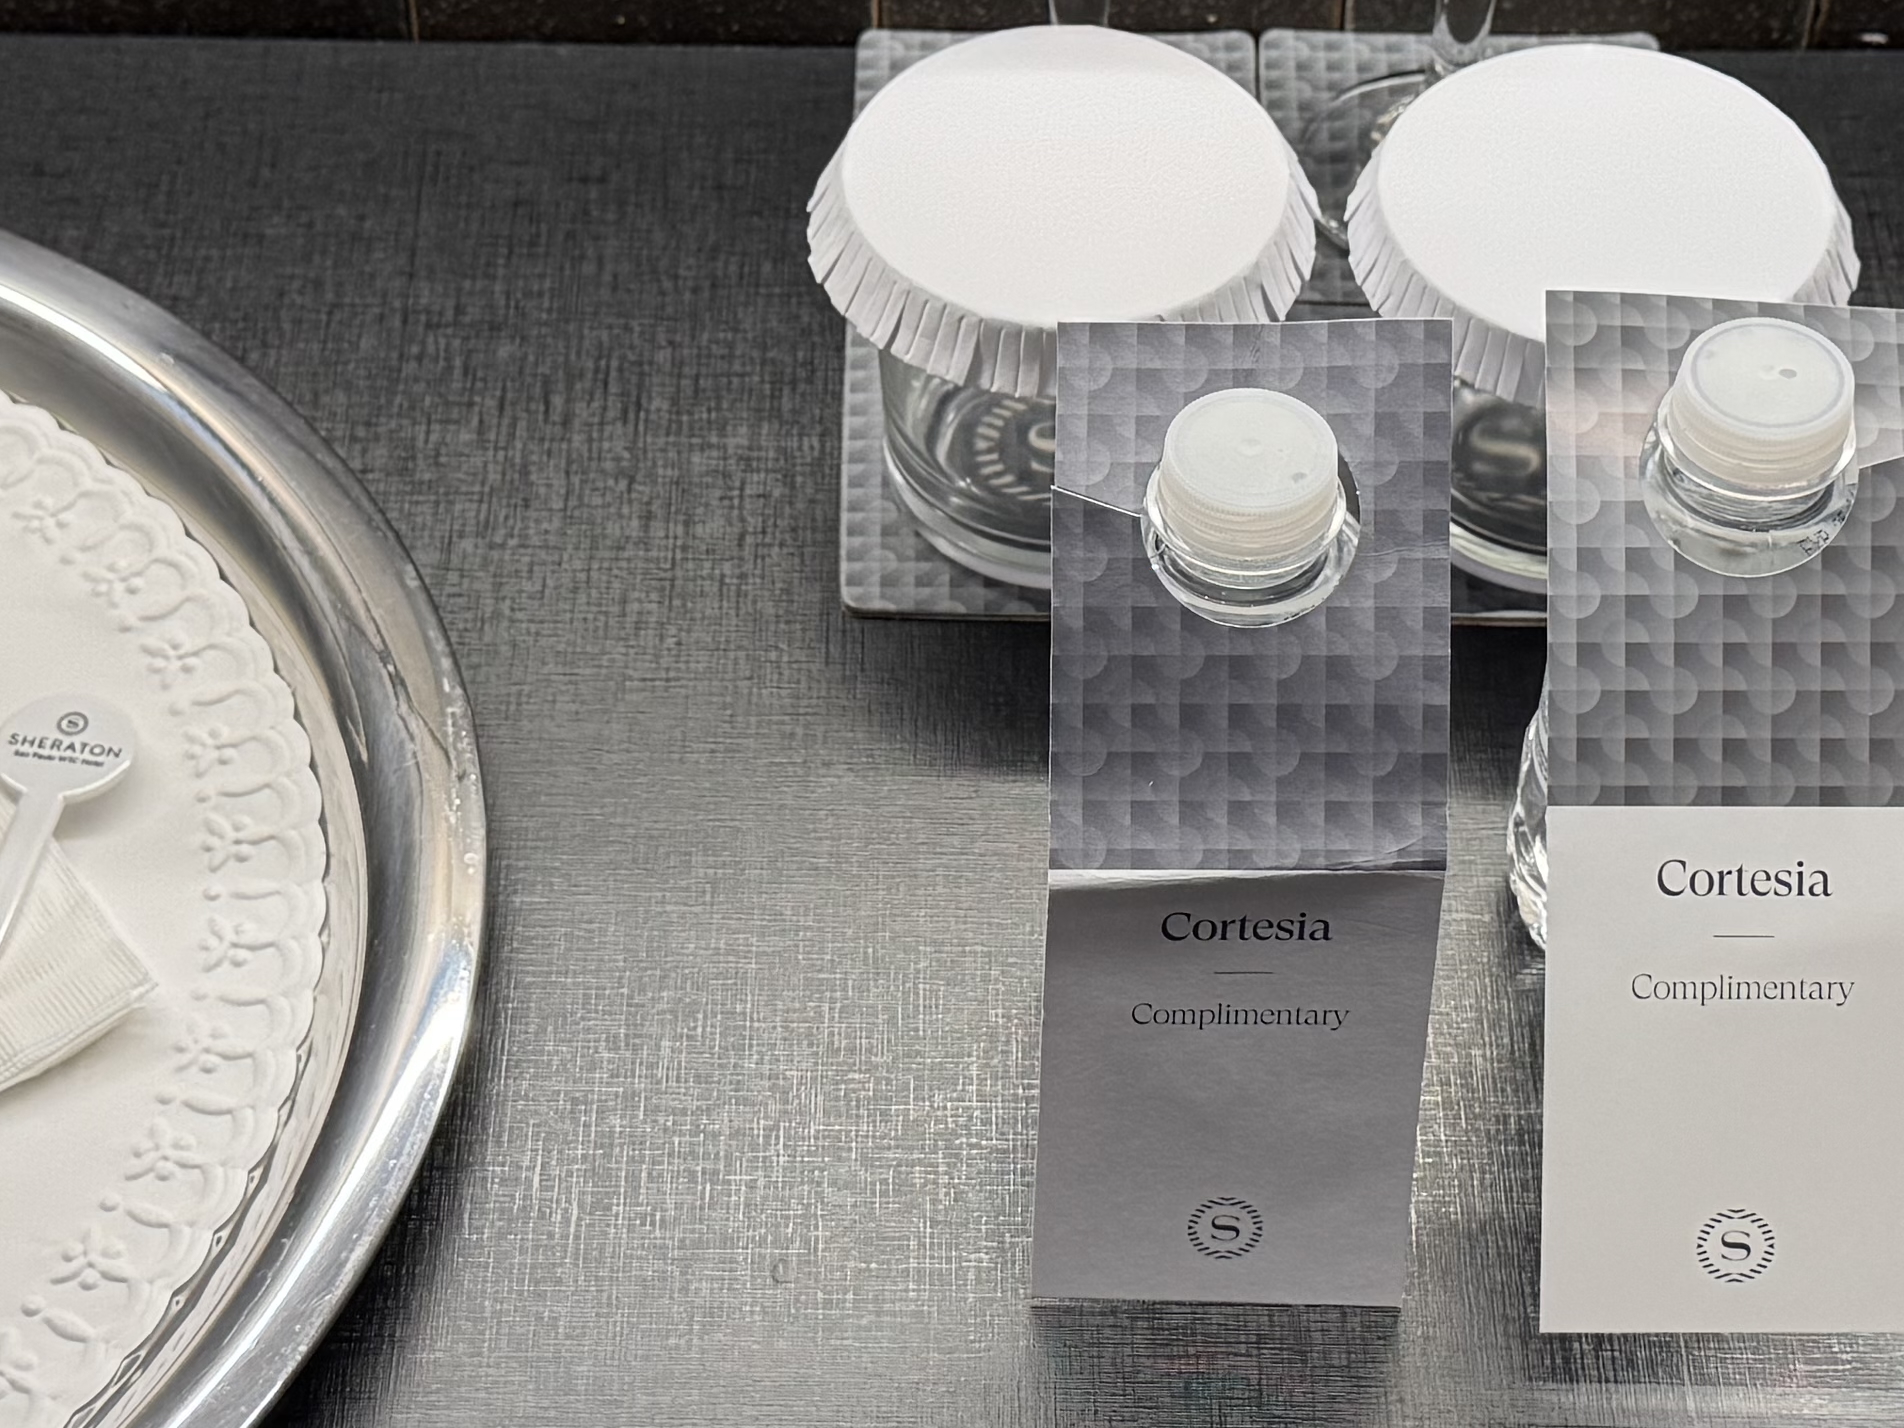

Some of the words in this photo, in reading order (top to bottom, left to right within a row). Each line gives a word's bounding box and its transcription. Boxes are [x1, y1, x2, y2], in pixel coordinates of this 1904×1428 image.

[8, 732, 123, 758] SHERATON
[1657, 859, 1833, 897] Cortesia
[1161, 912, 1333, 941] Cortesia
[1631, 973, 1855, 1006] Complimentary
[1132, 1002, 1350, 1031] Complimentary
[1211, 1214, 1240, 1241] S
[1721, 1230, 1751, 1261] S
